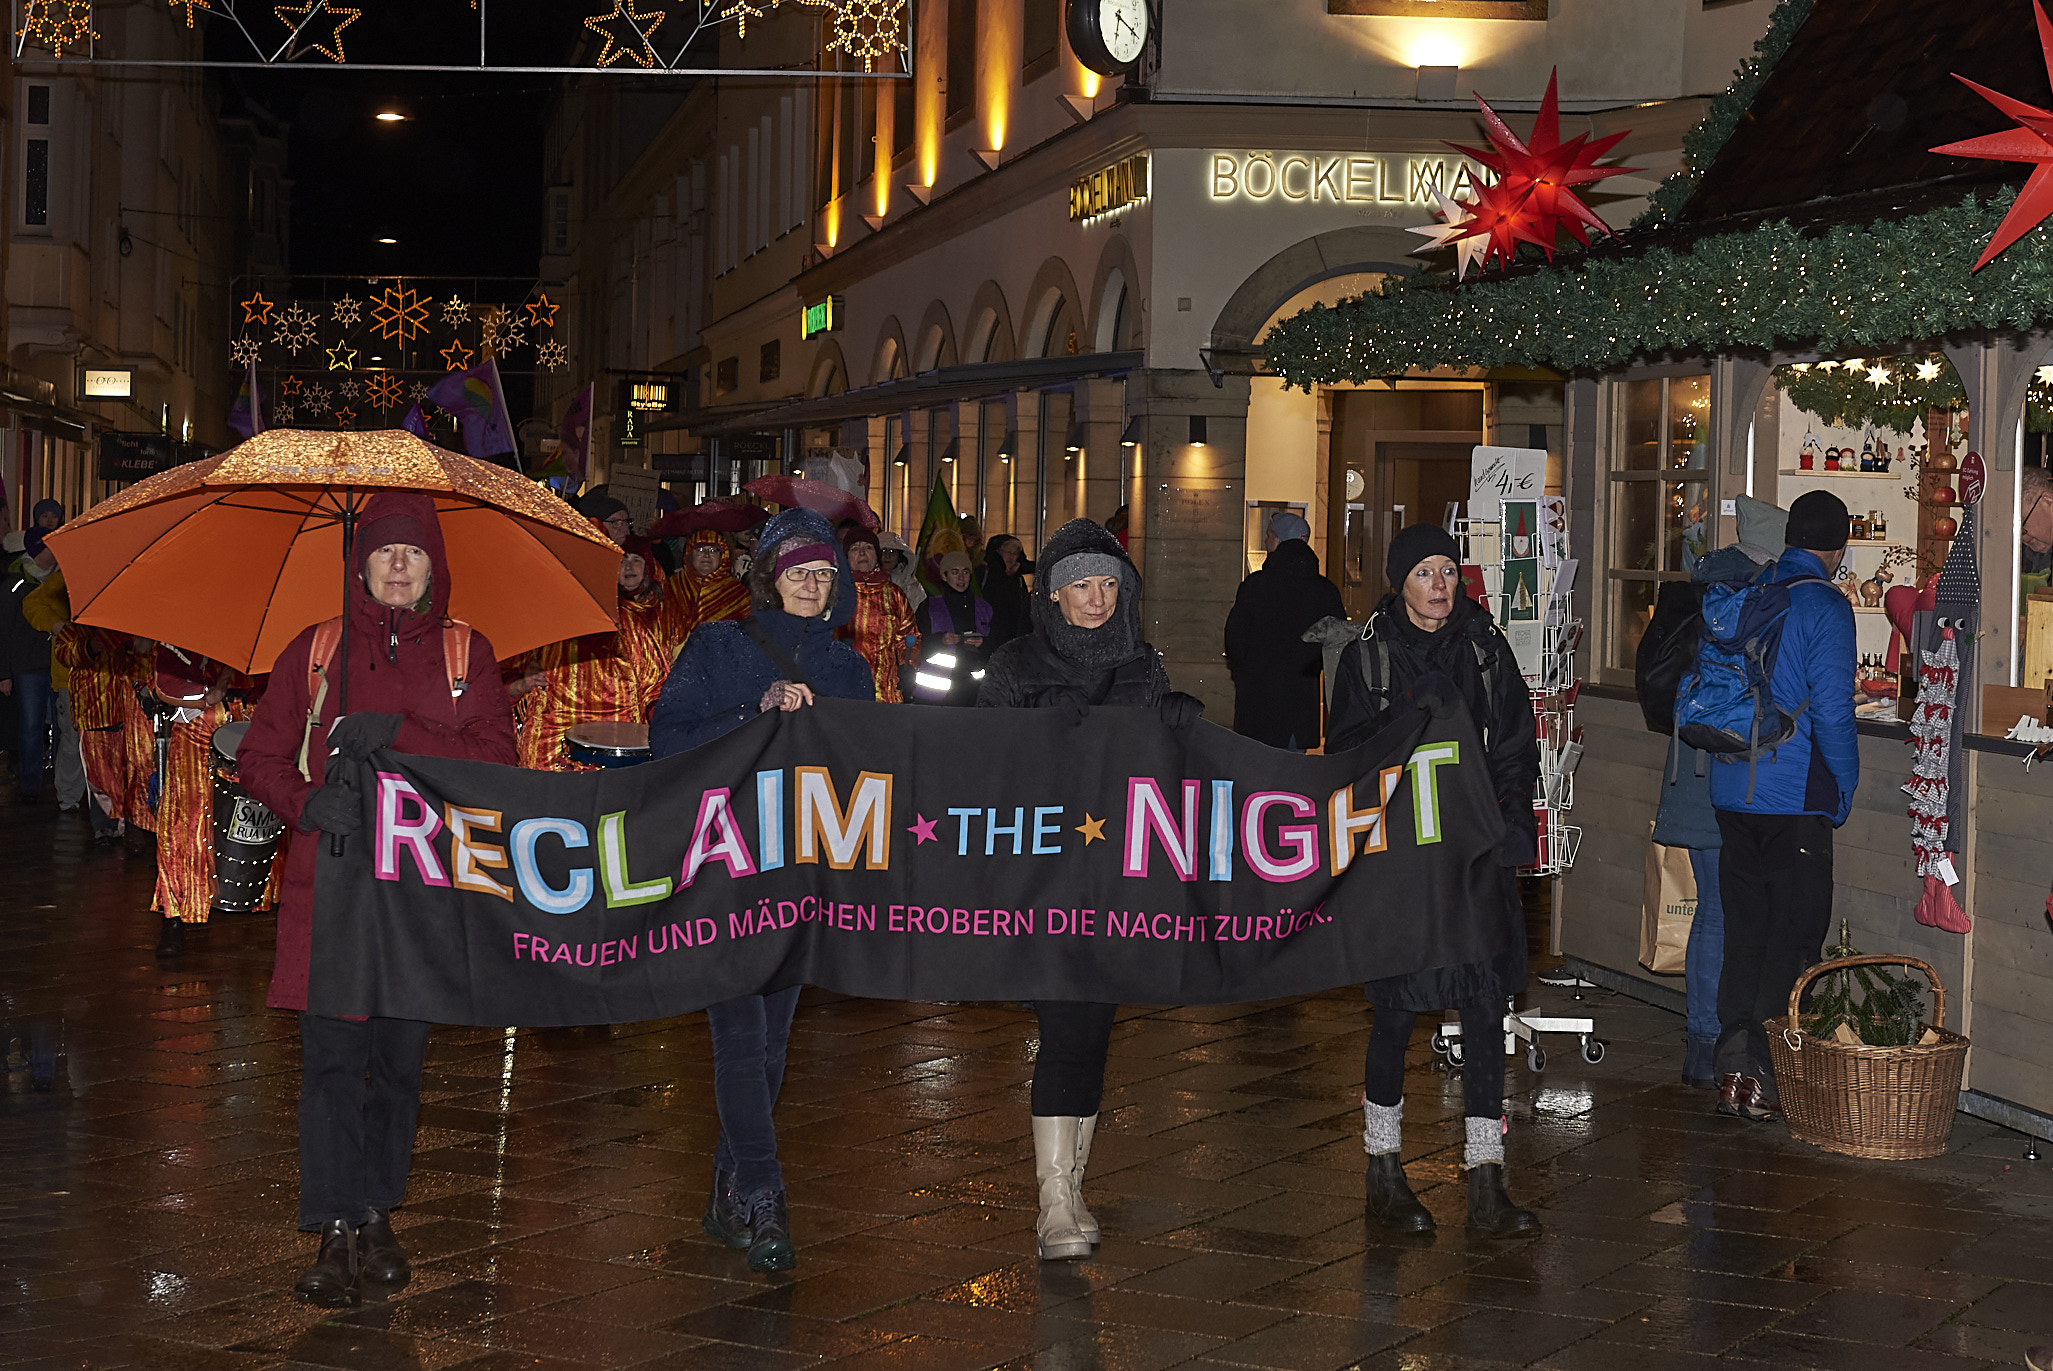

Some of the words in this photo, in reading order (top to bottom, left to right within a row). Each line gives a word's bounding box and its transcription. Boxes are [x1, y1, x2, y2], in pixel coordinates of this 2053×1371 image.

[374, 765, 893, 915] RECLAIM
[947, 805, 1064, 856] THE
[1122, 740, 1460, 883] NIGHT
[513, 926, 638, 967] FRAUEN
[648, 917, 718, 954] UND
[729, 895, 876, 940] MÄDCHEN
[888, 904, 1034, 936] EROBERN
[1047, 908, 1096, 936] DIE
[1106, 910, 1208, 942] NACHT
[1215, 901, 1333, 942] ZURÜCK.
[1666, 904, 1698, 916] unte
